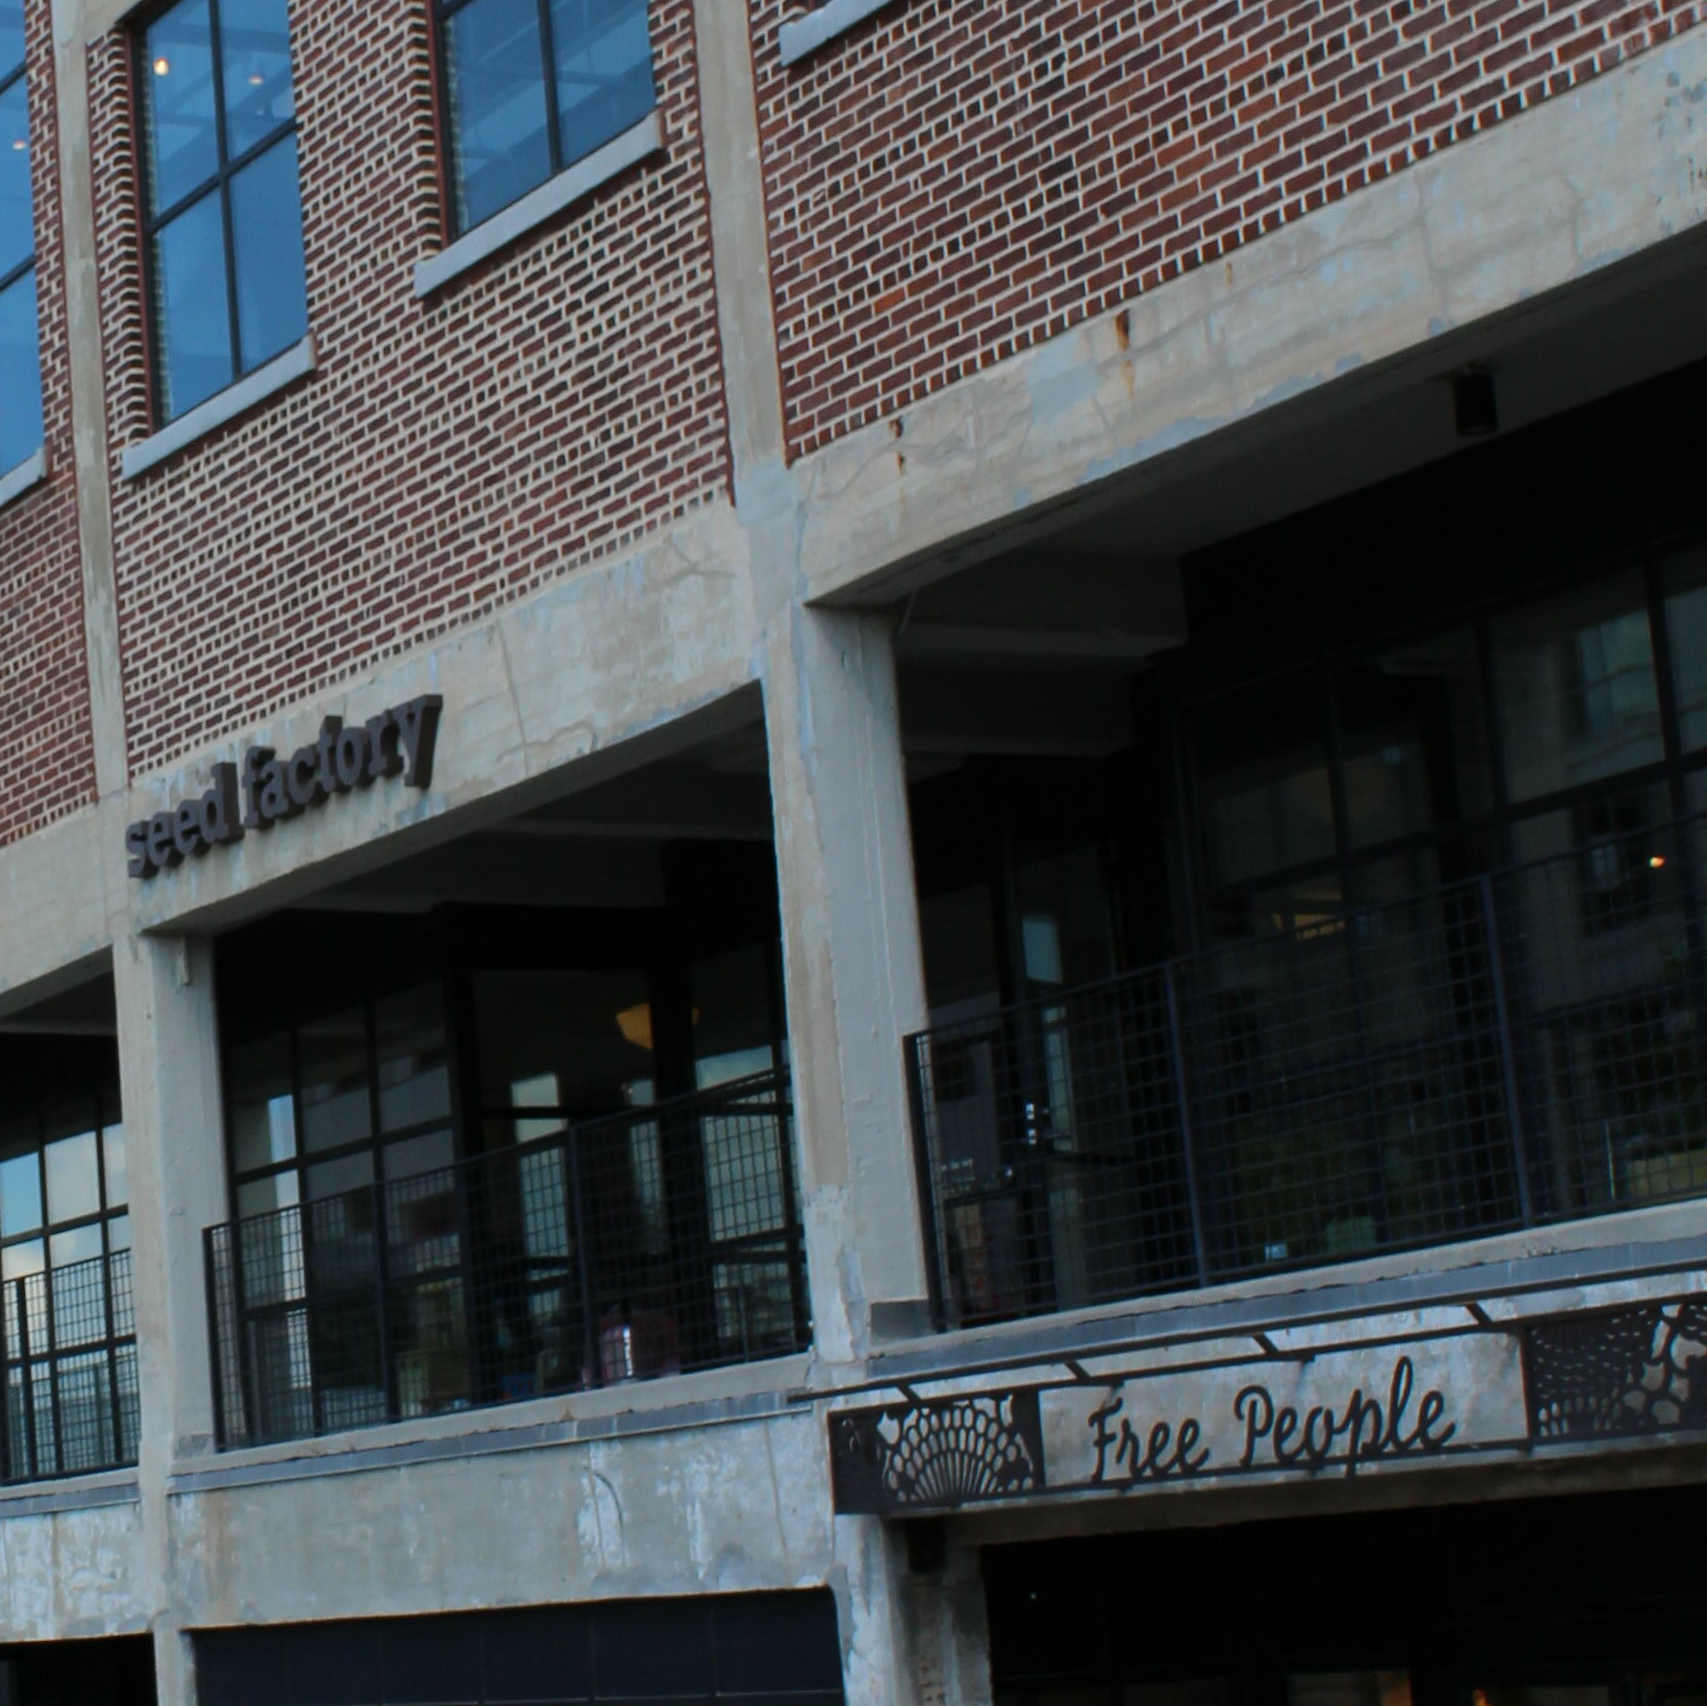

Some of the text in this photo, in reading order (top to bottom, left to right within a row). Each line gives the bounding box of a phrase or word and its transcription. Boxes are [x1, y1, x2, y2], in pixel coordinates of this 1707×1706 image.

[125, 693, 443, 880] seed factory
[1088, 1355, 1456, 1488] Free People
